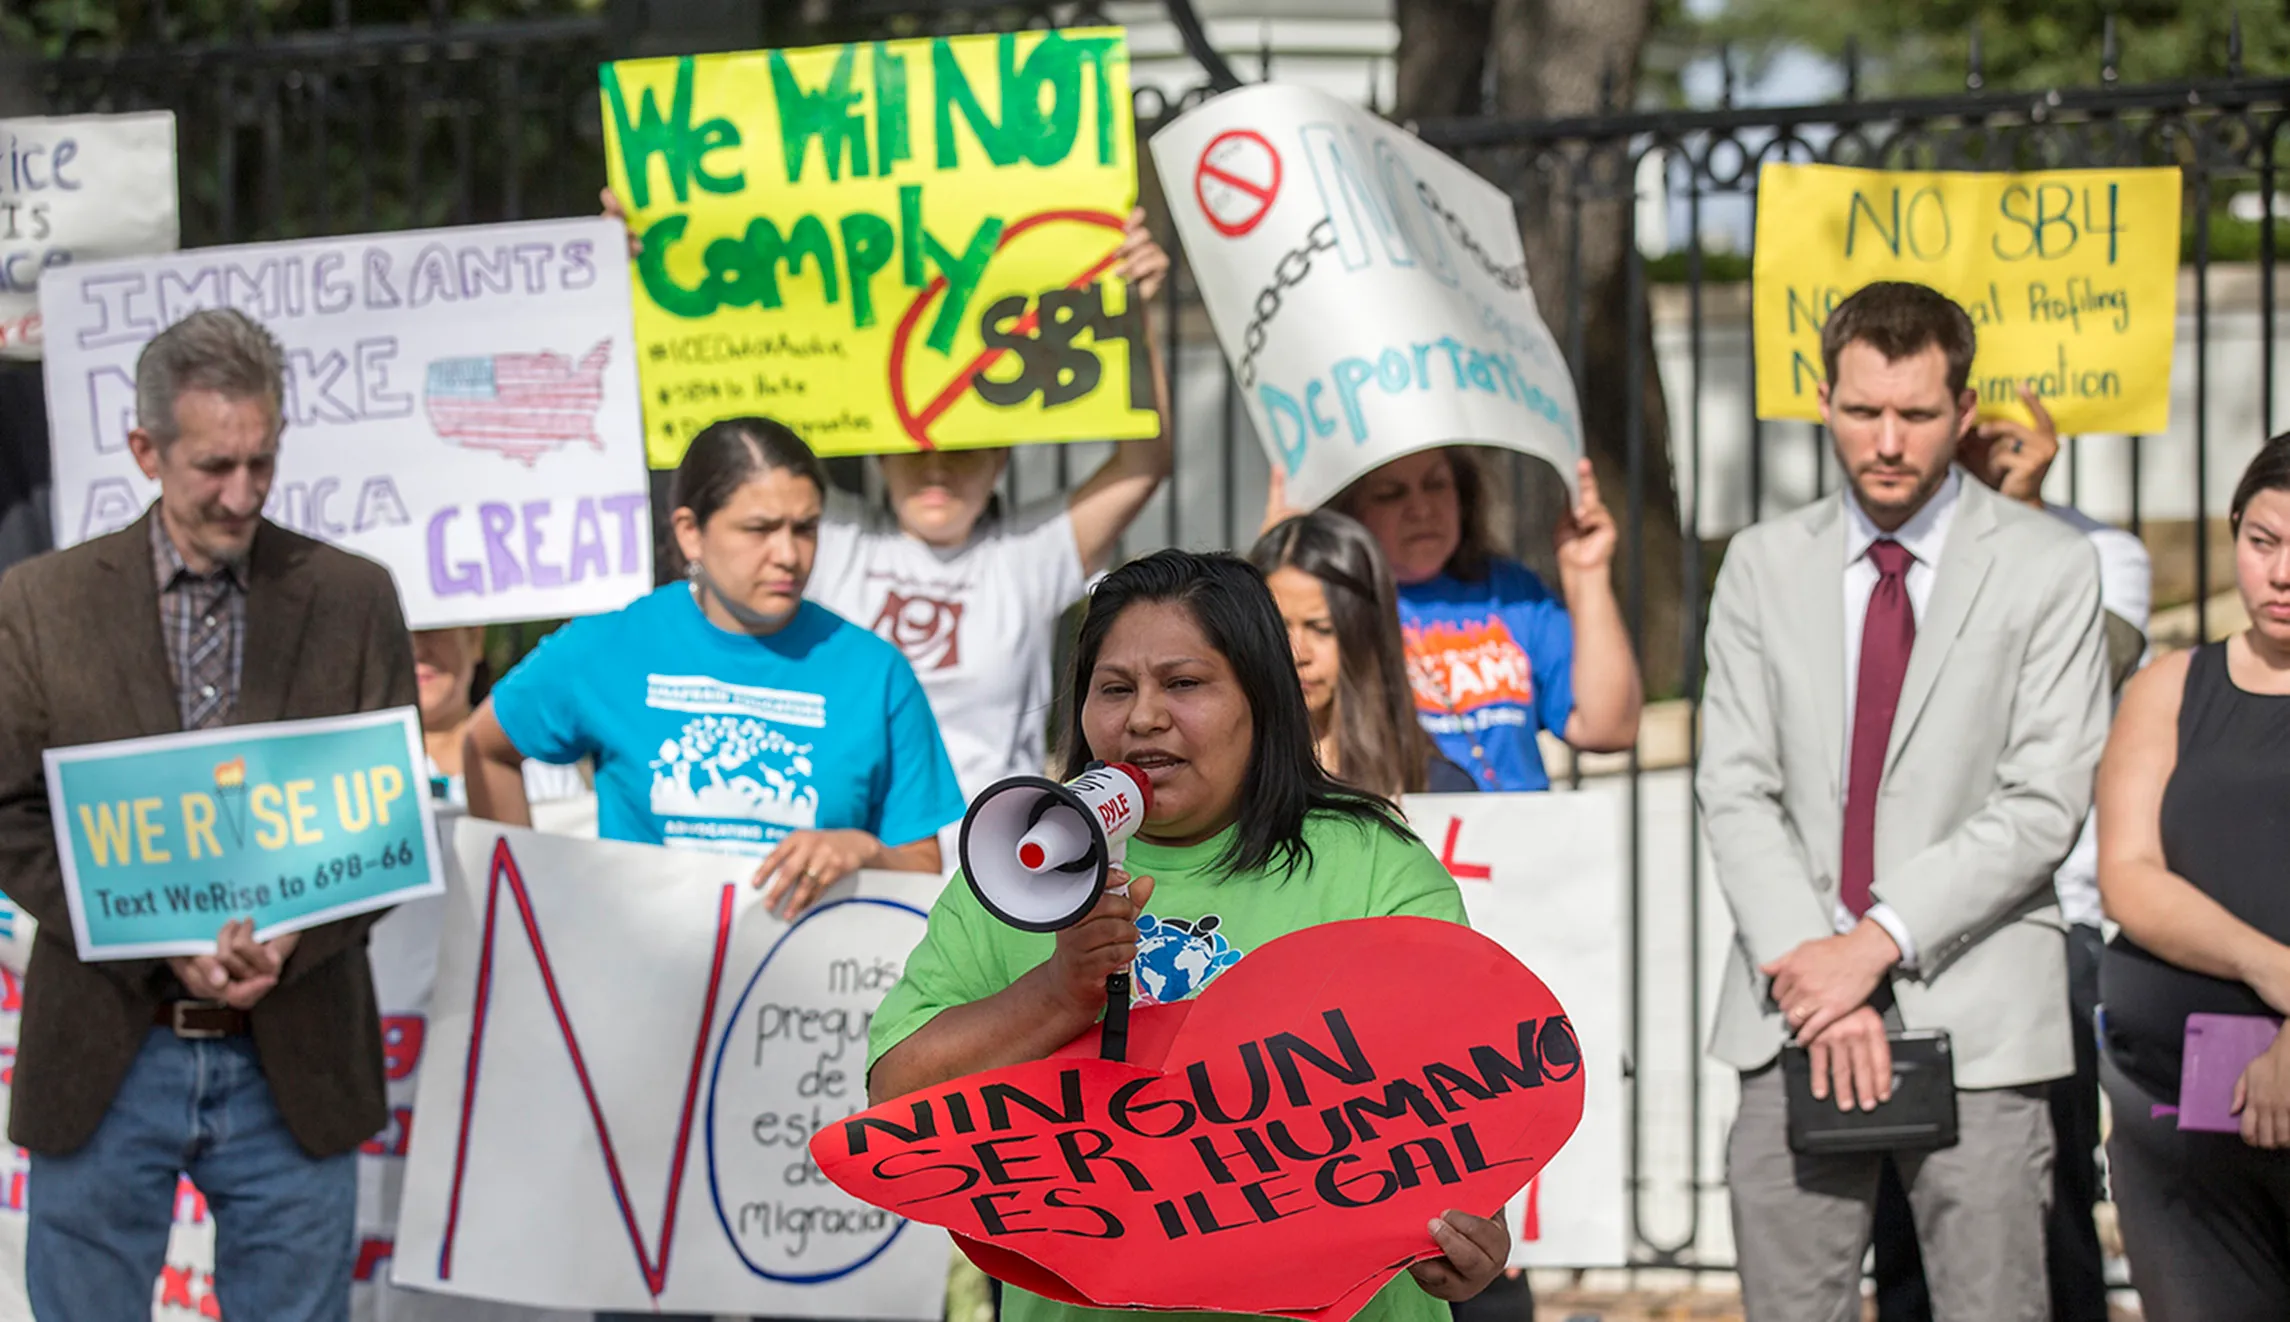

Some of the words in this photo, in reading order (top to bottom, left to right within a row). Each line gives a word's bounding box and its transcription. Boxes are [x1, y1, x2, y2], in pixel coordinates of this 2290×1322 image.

[0, 134, 82, 193] ice
[600, 55, 746, 209] We
[767, 41, 911, 184] Will
[932, 30, 1127, 169] NOT
[635, 185, 1003, 358] Comply
[1846, 187, 1950, 261] NO
[1992, 182, 2127, 265] SB4
[77, 240, 599, 353] IMMIGRANTS
[973, 281, 1155, 411] SB4
[2029, 276, 2130, 333] Profiling
[86, 334, 414, 456] MKE
[79, 474, 412, 546] AICA
[427, 492, 649, 598] GREAT
[77, 797, 171, 868] WE
[333, 765, 404, 833] UP
[1098, 792, 1130, 829] PYLE
[94, 887, 158, 919] Text
[164, 882, 270, 914] WeRise
[278, 874, 306, 897] to
[797, 1050, 847, 1098] de
[846, 1009, 1377, 1155] NINGUN
[872, 1129, 1154, 1207] SER
[1192, 1015, 1581, 1186] HUMANO
[968, 1188, 1125, 1239] ES
[1154, 1122, 1535, 1241] ILEGAL
